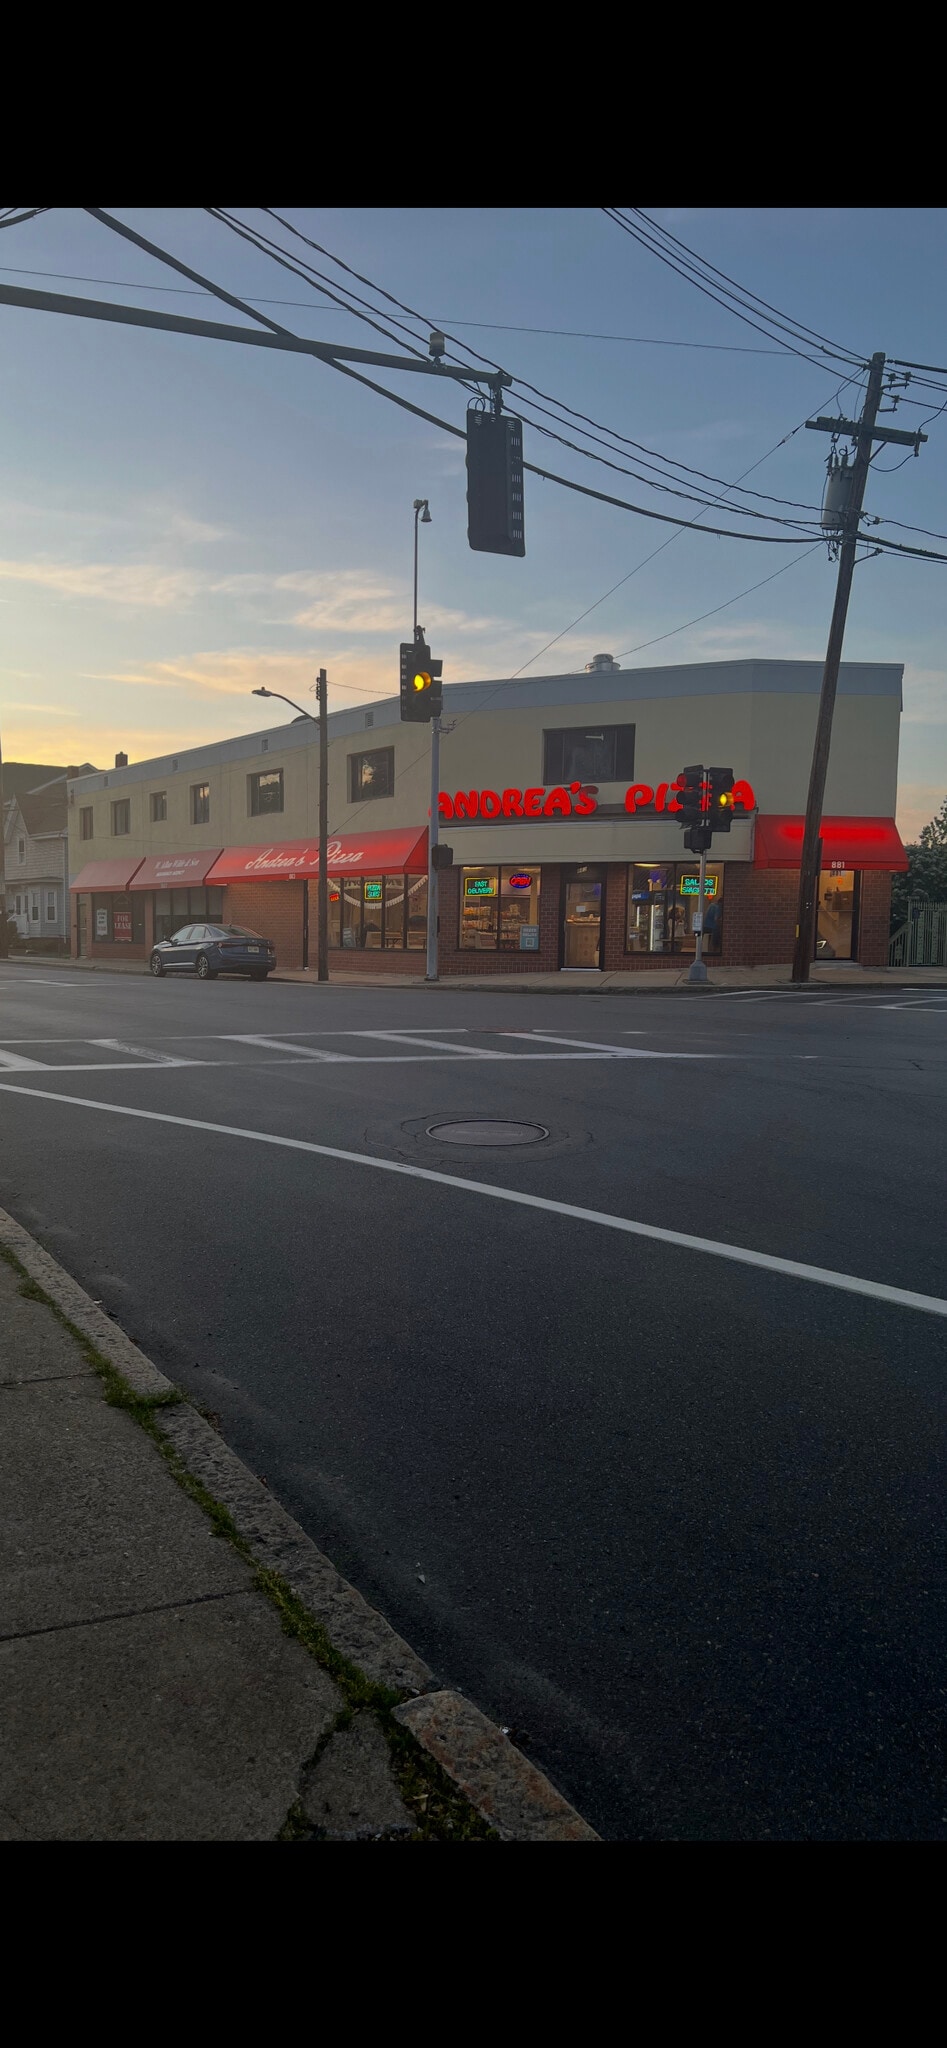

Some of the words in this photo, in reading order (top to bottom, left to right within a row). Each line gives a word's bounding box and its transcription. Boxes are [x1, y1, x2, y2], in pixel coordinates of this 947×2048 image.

[428, 781, 599, 819] ANDREA'S
[245, 848, 309, 870] Andrea's
[309, 841, 365, 866] Pizza
[831, 860, 845, 869] 881
[511, 877, 531, 885] OPEN
[685, 878, 714, 886] SALDS
[117, 914, 129, 922] FOR
